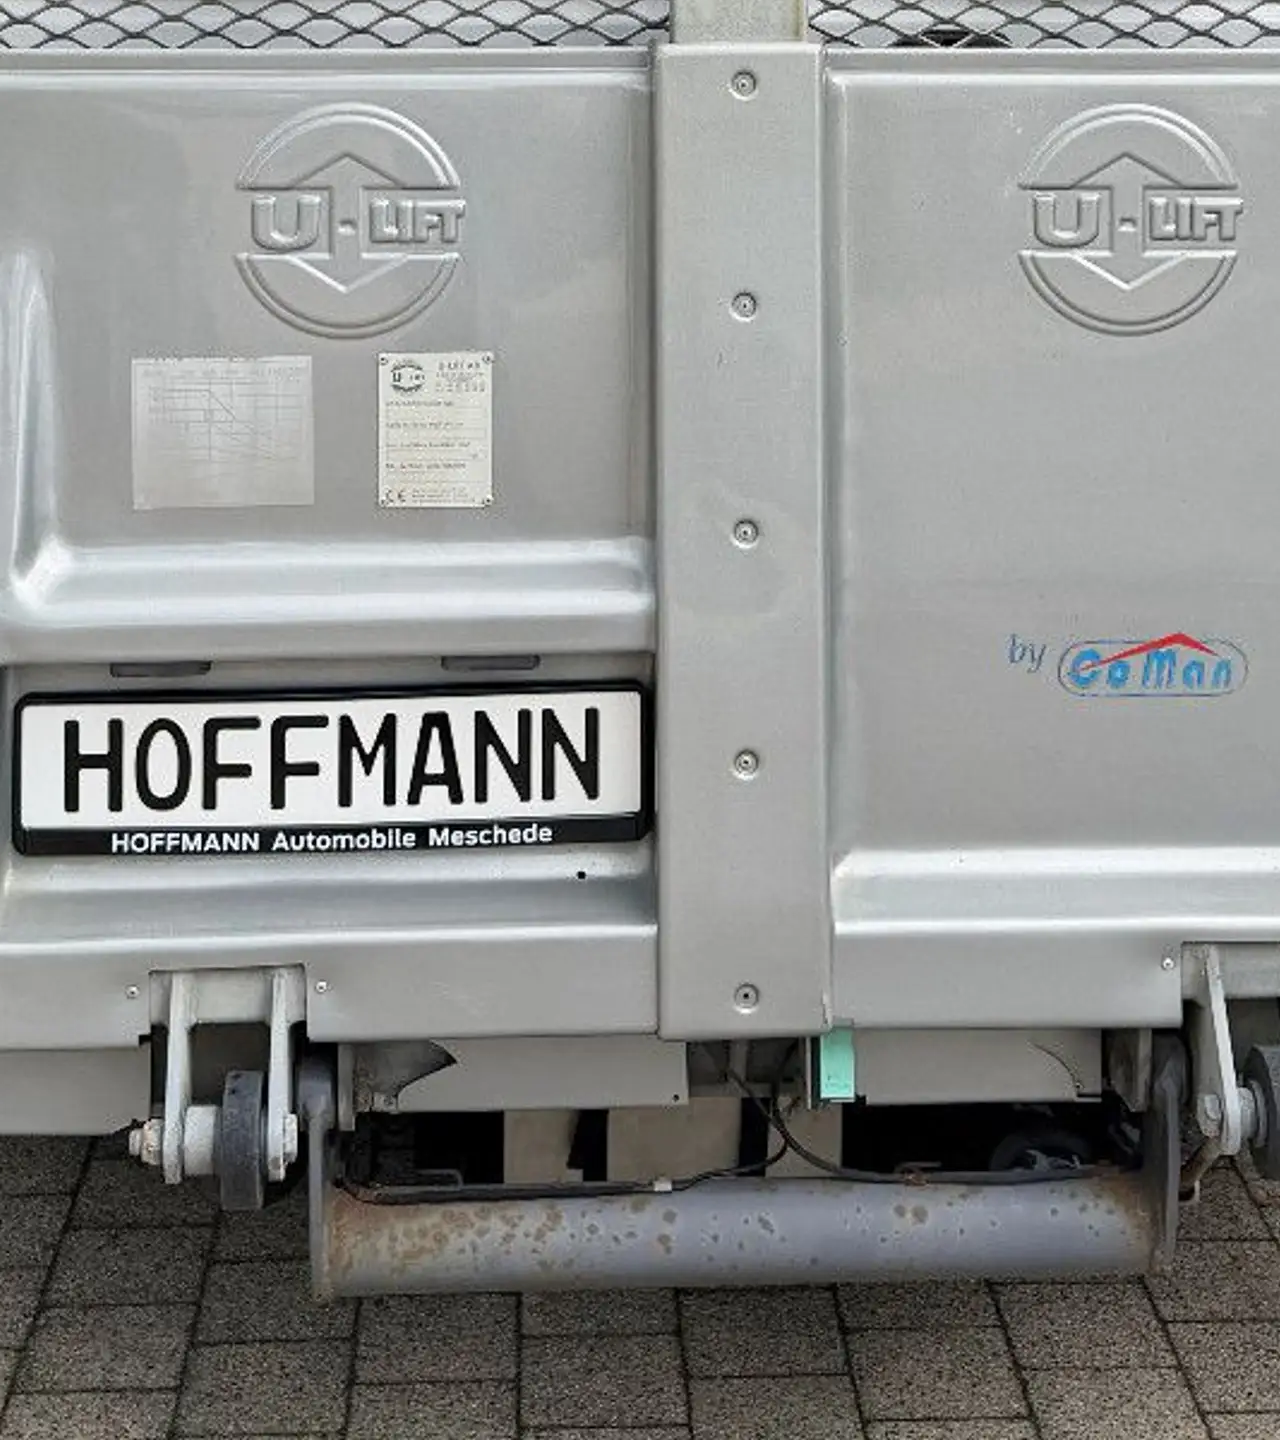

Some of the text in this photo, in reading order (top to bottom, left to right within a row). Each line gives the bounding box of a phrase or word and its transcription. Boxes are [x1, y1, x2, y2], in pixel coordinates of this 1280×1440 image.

[250, 193, 467, 251] U-LIFT
[1032, 192, 1245, 249] U-LIFT
[1008, 631, 1048, 673] by
[62, 706, 602, 813] HOFFMANN
[110, 822, 554, 854] HOFFMANN Automobile Meschede
